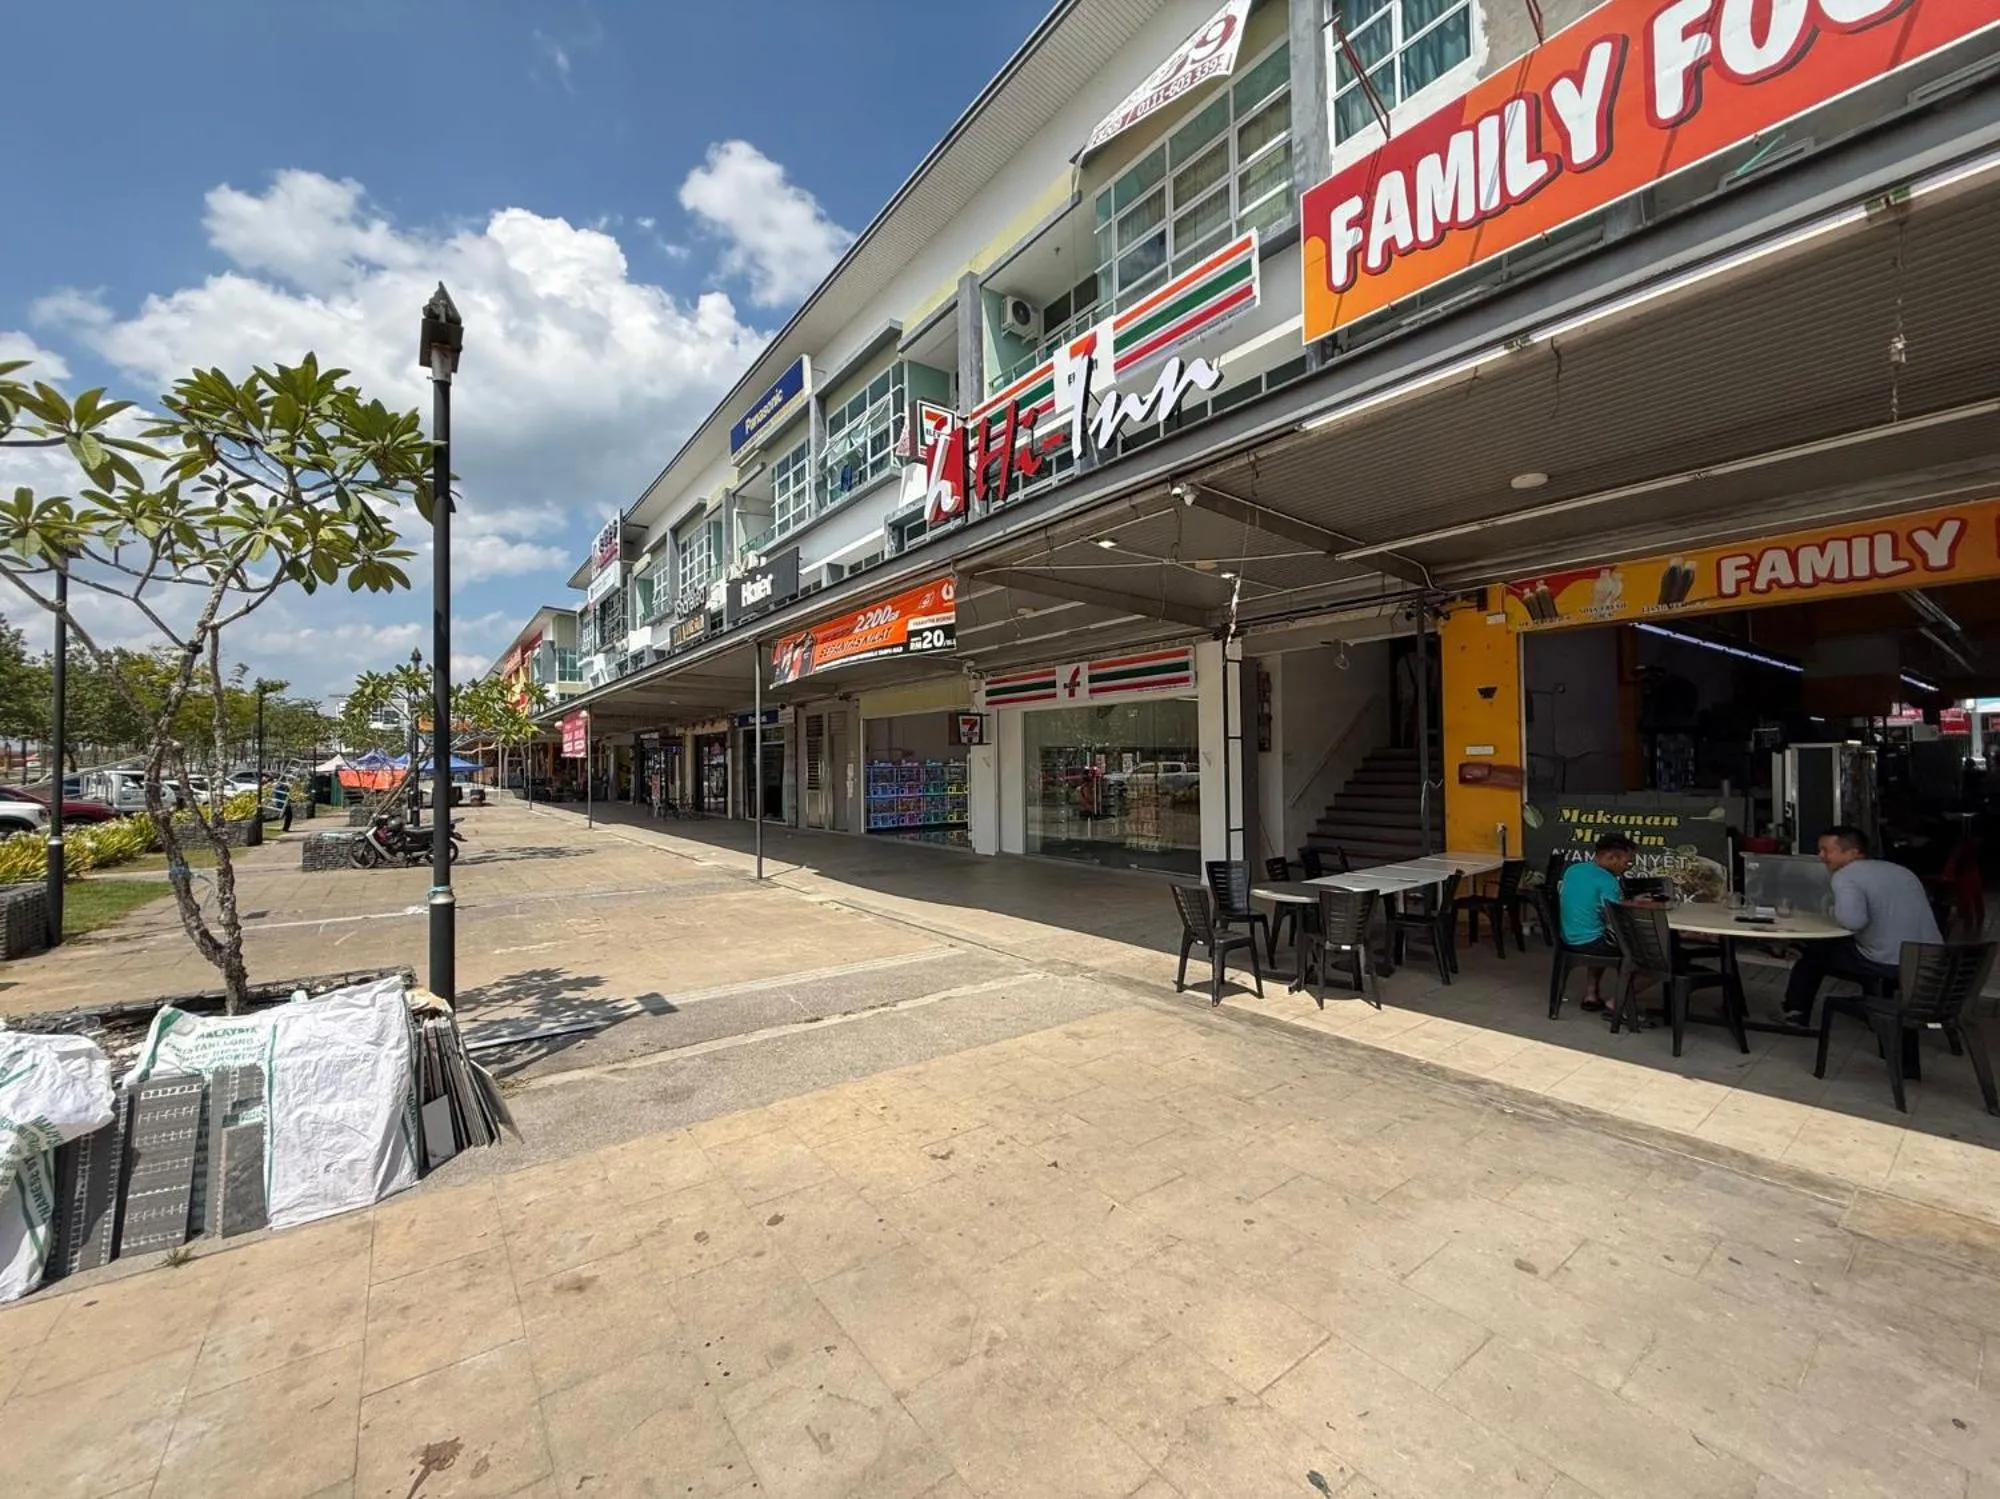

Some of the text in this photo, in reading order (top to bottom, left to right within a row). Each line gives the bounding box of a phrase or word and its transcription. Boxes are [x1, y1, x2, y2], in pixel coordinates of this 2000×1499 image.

[1329, 0, 1892, 289] FAMILY FO
[744, 388, 783, 434] Panasonic
[1720, 519, 1961, 595] FAMILY
[741, 574, 773, 607] Haier
[1558, 807, 1681, 827] Makanan
